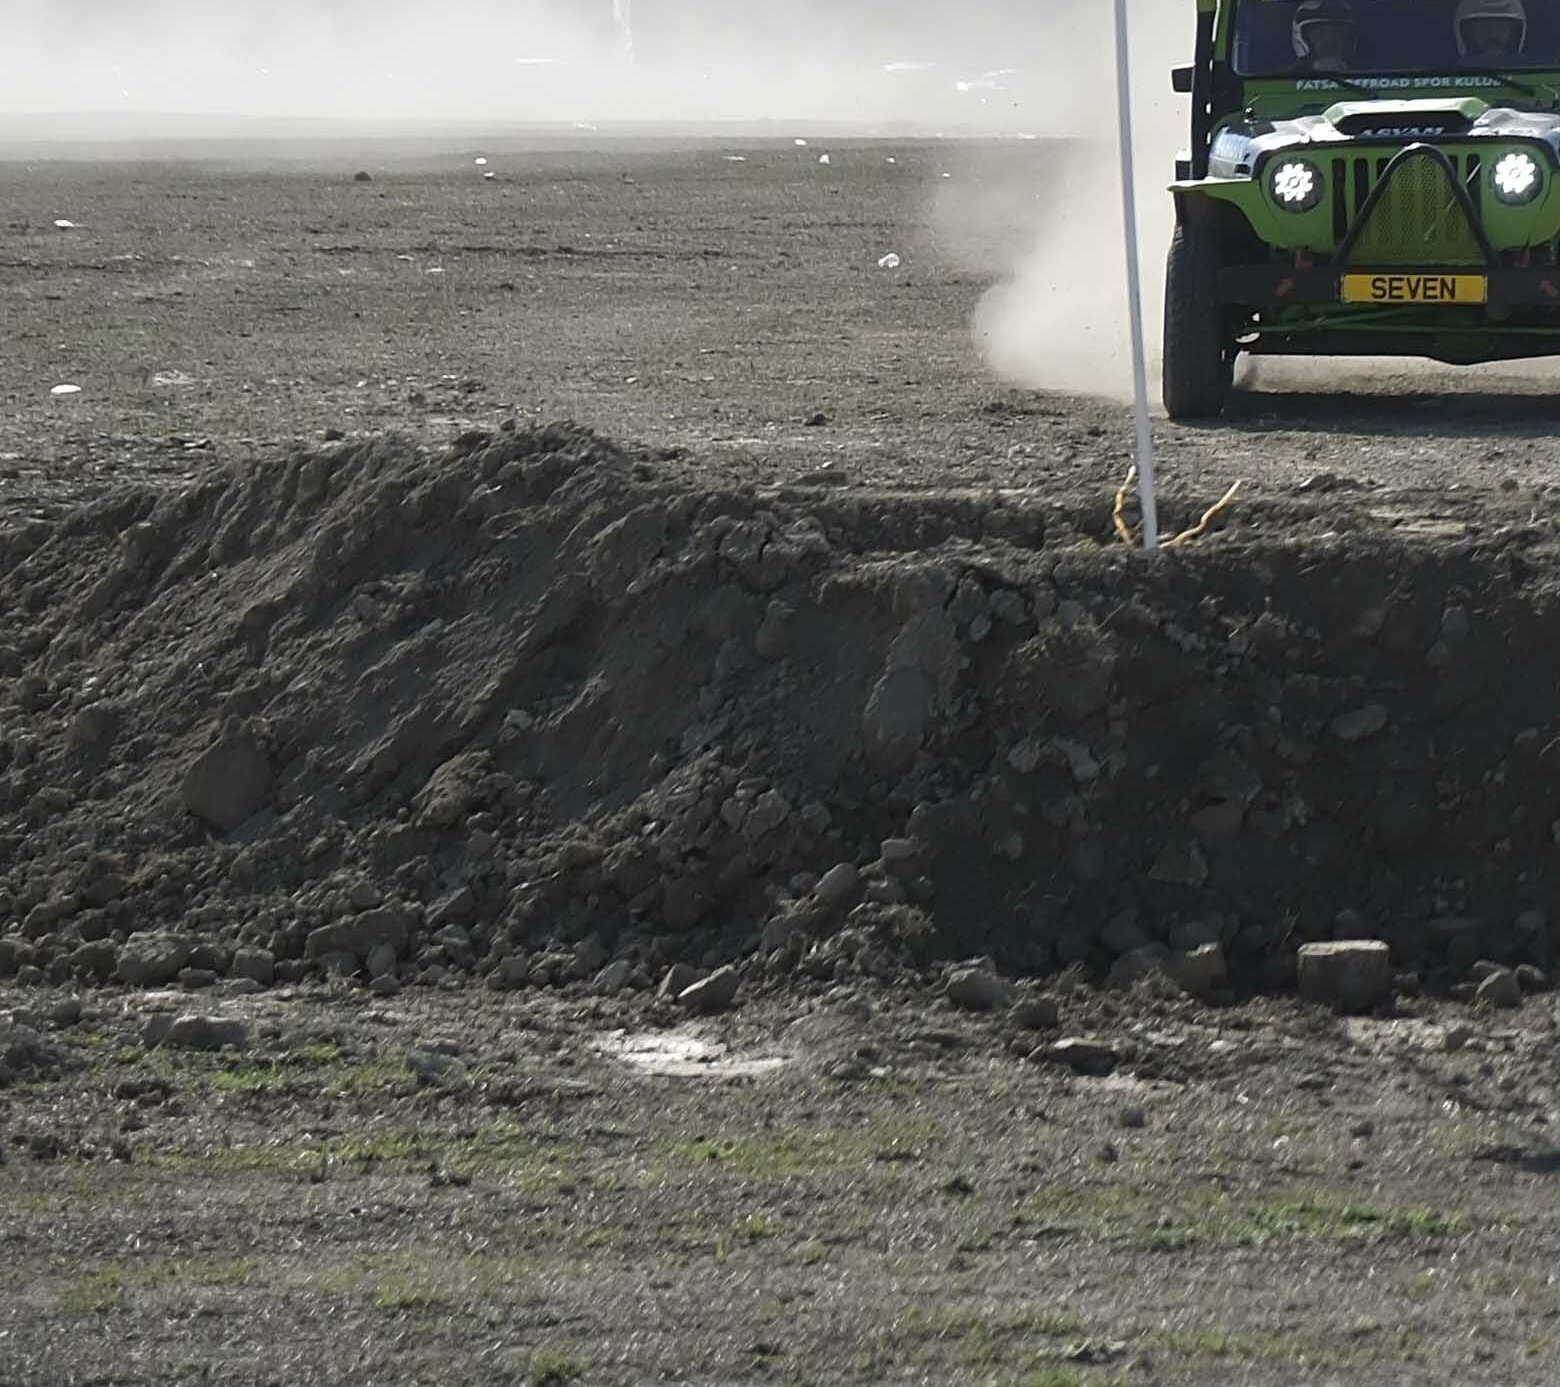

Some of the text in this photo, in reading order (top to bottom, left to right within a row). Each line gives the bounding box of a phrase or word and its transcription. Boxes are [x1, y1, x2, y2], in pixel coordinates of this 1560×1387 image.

[1296, 79, 1339, 91] FATSA
[1414, 76, 1449, 88] SPOR
[1371, 277, 1456, 300] SEVEN
